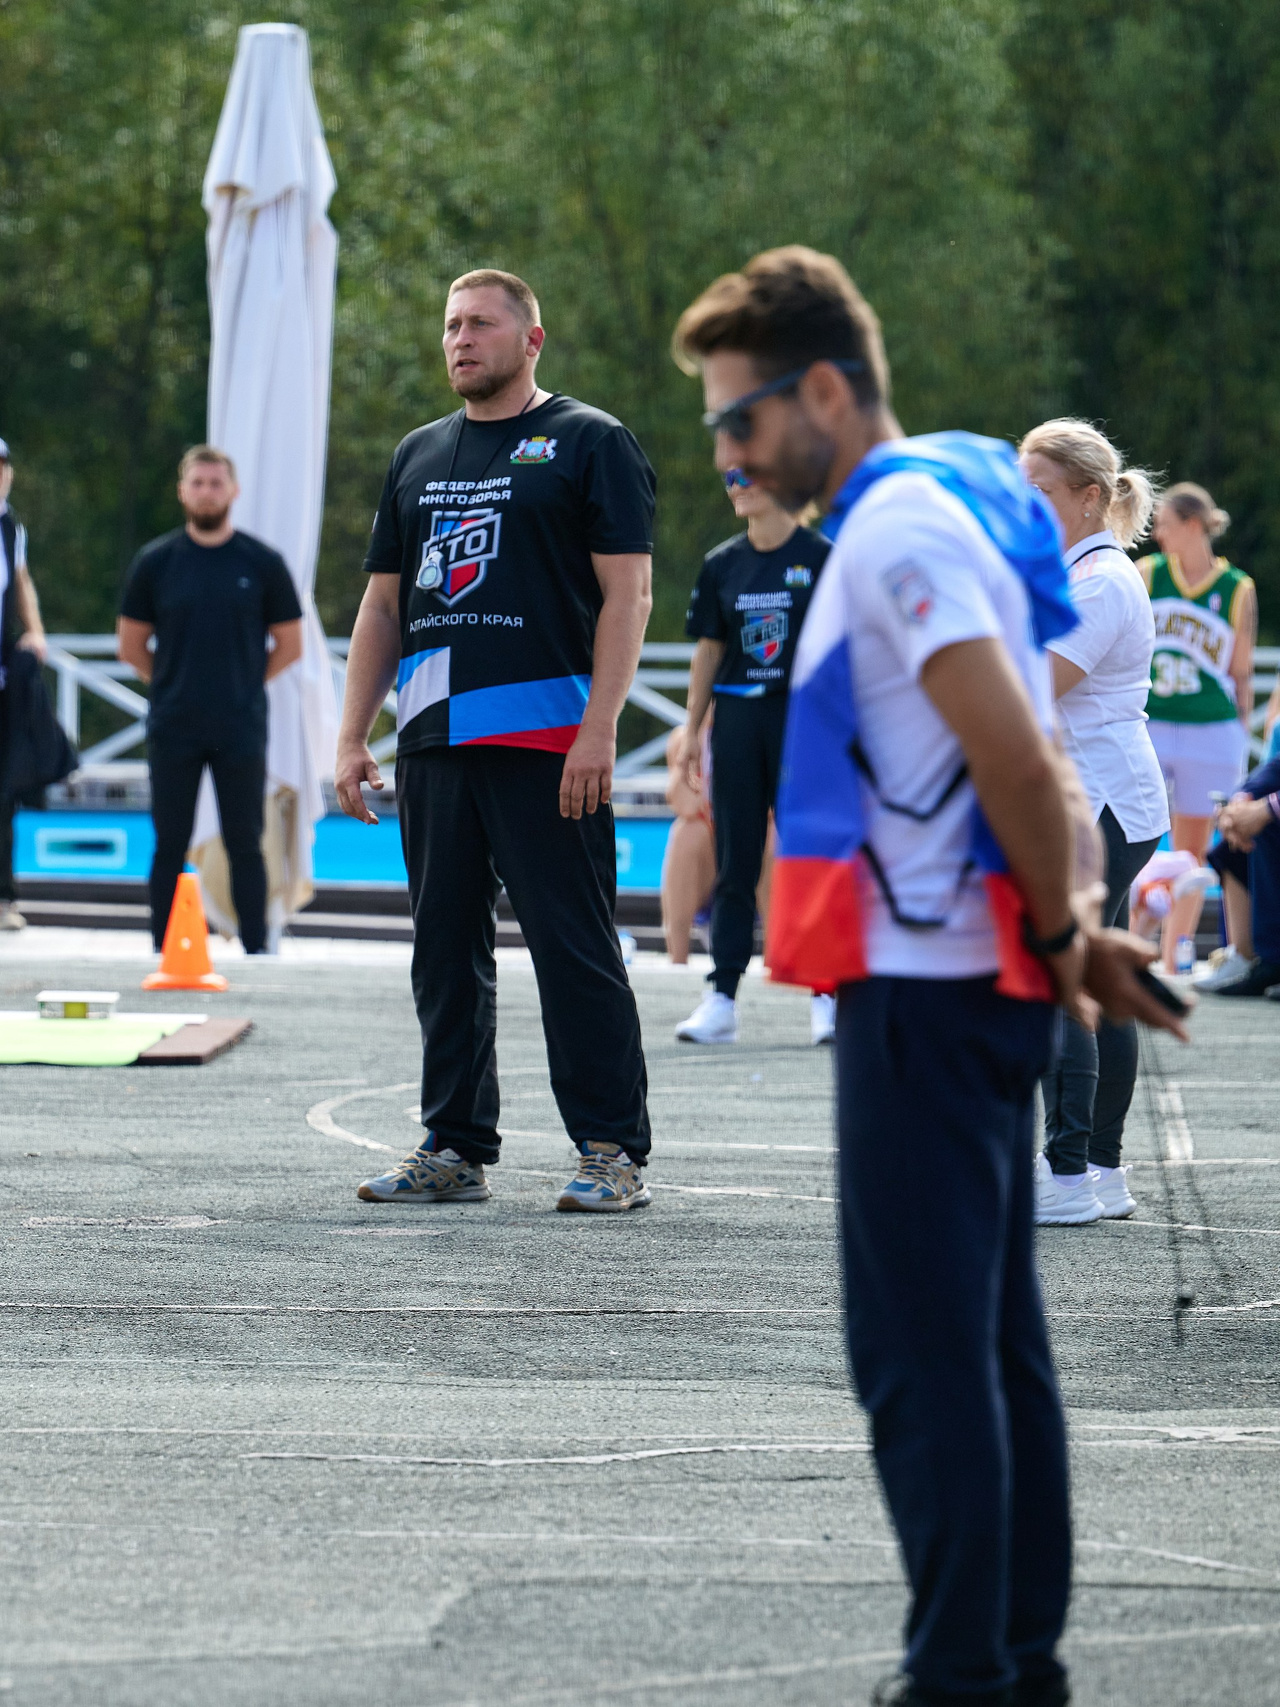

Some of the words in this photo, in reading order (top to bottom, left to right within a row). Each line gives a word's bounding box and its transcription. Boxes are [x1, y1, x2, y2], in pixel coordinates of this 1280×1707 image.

[425, 477, 511, 492] ФЕДЕРАЦИЯ
[418, 490, 511, 505] МНОГОБОРЬЯ
[409, 613, 478, 634] АЛТАЙСКОГО
[482, 613, 524, 628] КРАЯ
